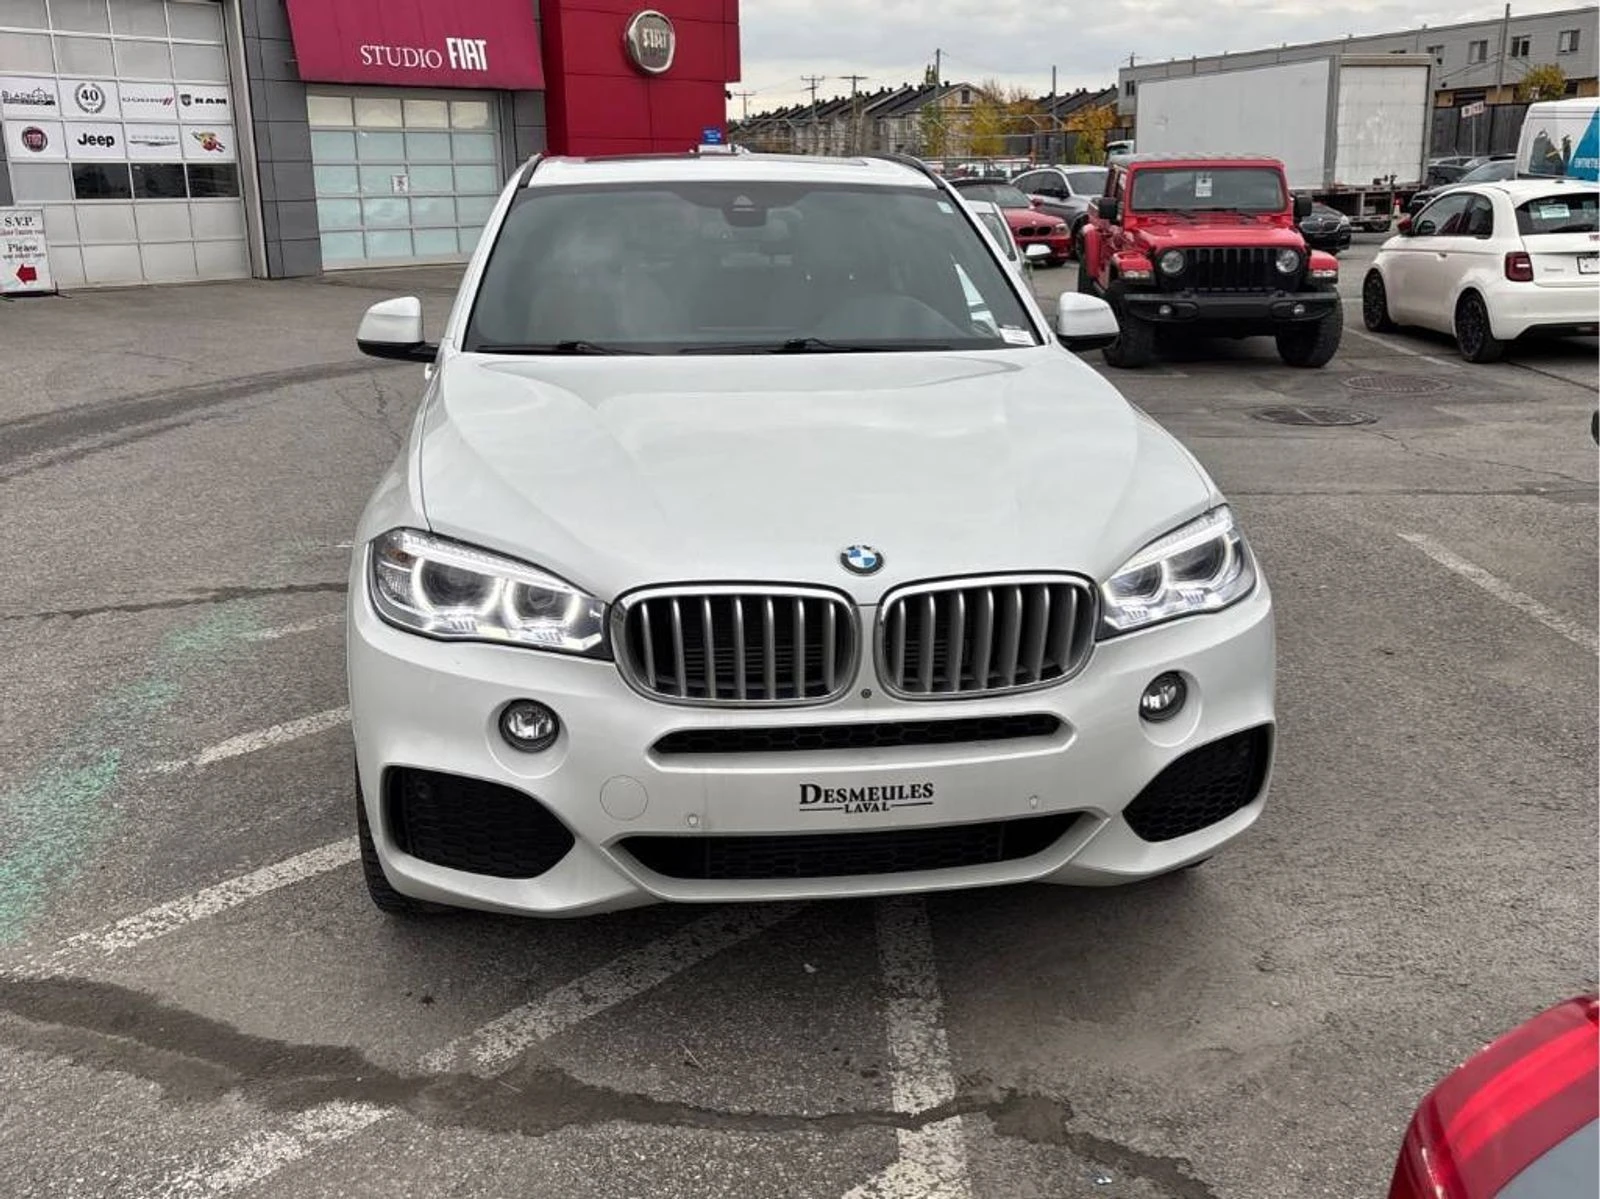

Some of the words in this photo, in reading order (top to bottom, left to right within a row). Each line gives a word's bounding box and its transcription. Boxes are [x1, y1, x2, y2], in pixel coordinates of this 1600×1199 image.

[360, 45, 442, 69] STUDIO
[446, 37, 487, 70] FIAT
[81, 89, 99, 101] 40
[77, 133, 115, 148] Jeep
[5, 216, 34, 227] S.V.P.
[844, 801, 890, 813] LAVAL
